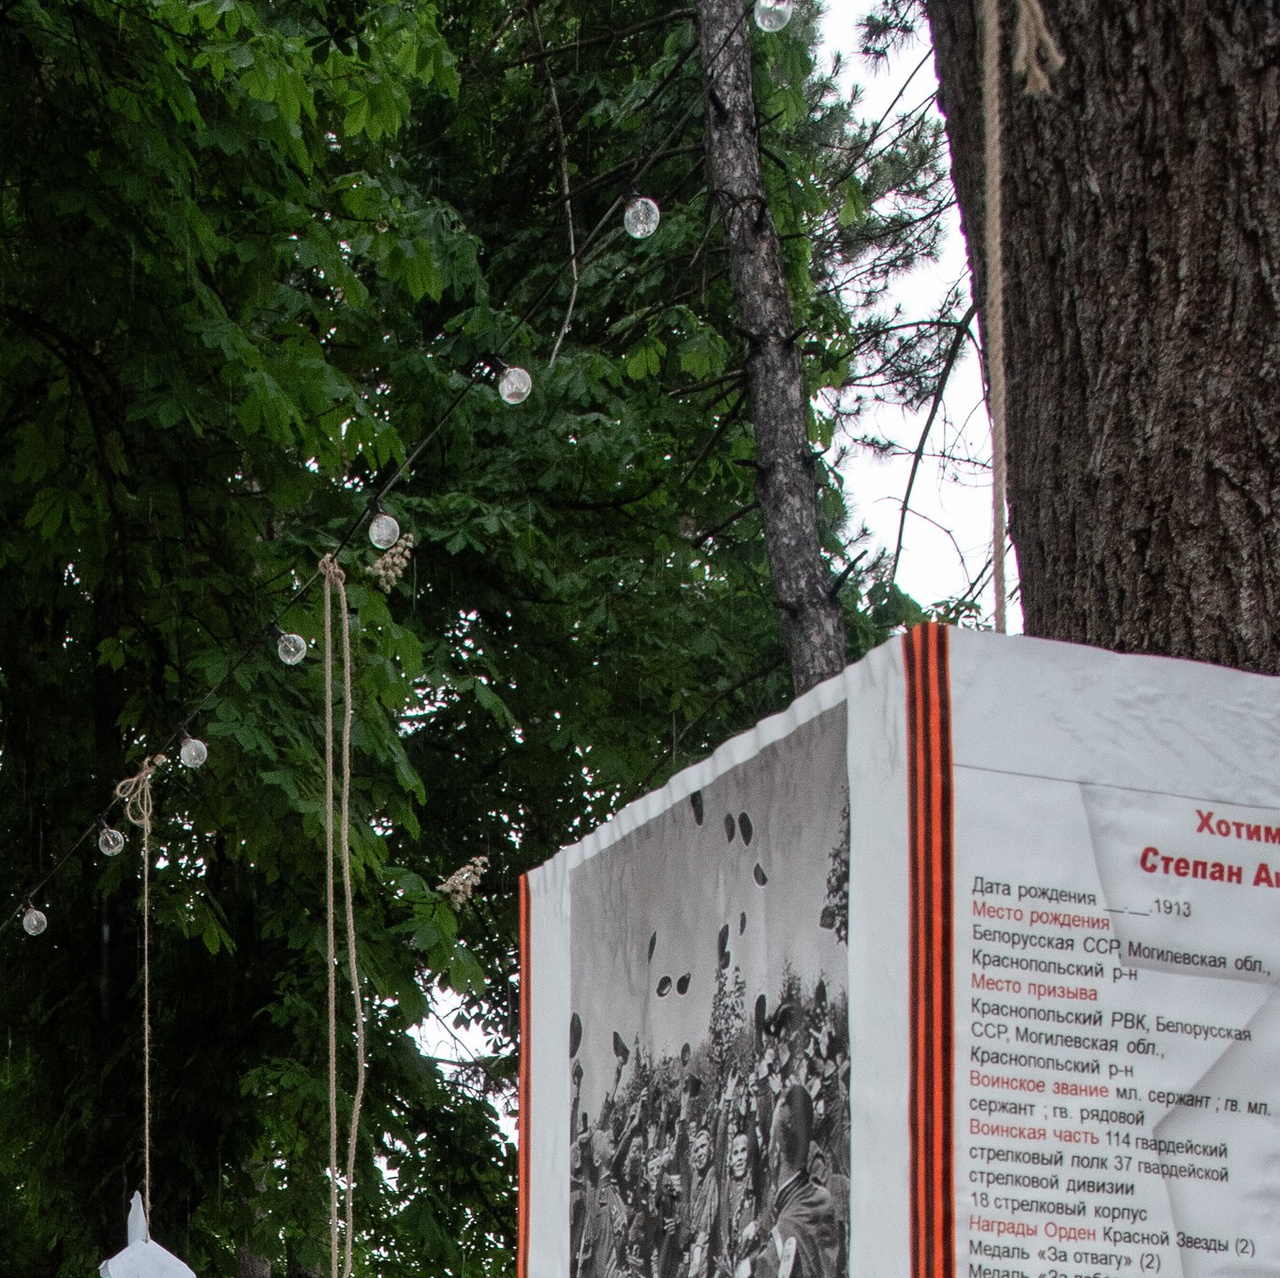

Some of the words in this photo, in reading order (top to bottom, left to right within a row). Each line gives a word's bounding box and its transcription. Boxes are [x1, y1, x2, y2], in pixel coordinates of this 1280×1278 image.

[1140, 847, 1242, 884] Степан
[972, 877, 1010, 895] Дата
[1018, 885, 1096, 905] рождения
[972, 900, 1023, 921] Место
[1030, 910, 1109, 930] рождения
[972, 949, 1104, 977] Краснопольский
[1113, 968, 1137, 983] р-н
[973, 924, 1074, 950] Белорусская
[1083, 937, 1121, 958] ССР,
[1128, 941, 1226, 968] Могилевская
[1234, 954, 1271, 975] обл.,
[972, 973, 1021, 993] Место
[1028, 983, 1098, 1001] призыва
[971, 998, 1103, 1026] Краснопольский
[1111, 1013, 1150, 1034] РВК,
[1156, 1017, 1252, 1042] Белорусская
[971, 1022, 1009, 1043] ССР,
[1016, 1028, 1118, 1052] Могилевская
[1127, 1041, 1165, 1059] обл.,
[970, 1047, 1100, 1075] Краснопольский
[1108, 1064, 1133, 1079] р-н
[969, 1070, 1045, 1093] Воинское
[1052, 1081, 1108, 1098] звание
[1116, 1086, 1141, 1102] мл.
[1148, 1090, 1210, 1109] сержант
[1225, 1098, 1241, 1113] гв.
[1248, 1101, 1272, 1116] мл.
[969, 1098, 1035, 1118] сержант
[1054, 1105, 1073, 1119] гв.
[1080, 1106, 1144, 1126] рядовой
[969, 1118, 1046, 1141] Воинская
[1054, 1129, 1099, 1145] часть
[1106, 1130, 1130, 1147] 114
[1135, 1136, 1227, 1158] гвардейский
[969, 1145, 1063, 1167] стрелковый
[1071, 1153, 1108, 1170] полк
[1115, 1156, 1132, 1172] 37
[1139, 1159, 1229, 1182] гвардейской
[969, 1168, 1059, 1192] стрелковой
[1066, 1177, 1135, 1195] дивизии
[972, 1193, 989, 1208] 18
[994, 1196, 1085, 1218] стрелковый
[1094, 1204, 1147, 1224] корпус
[969, 1216, 1037, 1239] Награды
[1044, 1222, 1096, 1241] Орден
[1103, 1226, 1169, 1246] Красной
[1176, 1232, 1229, 1252] Звезды
[1234, 1239, 1255, 1257] (2)
[969, 1241, 1030, 1261] Медаль
[1038, 1247, 1067, 1262] «За
[1074, 1251, 1132, 1268] отвагу»
[1139, 1254, 1161, 1272] (2)
